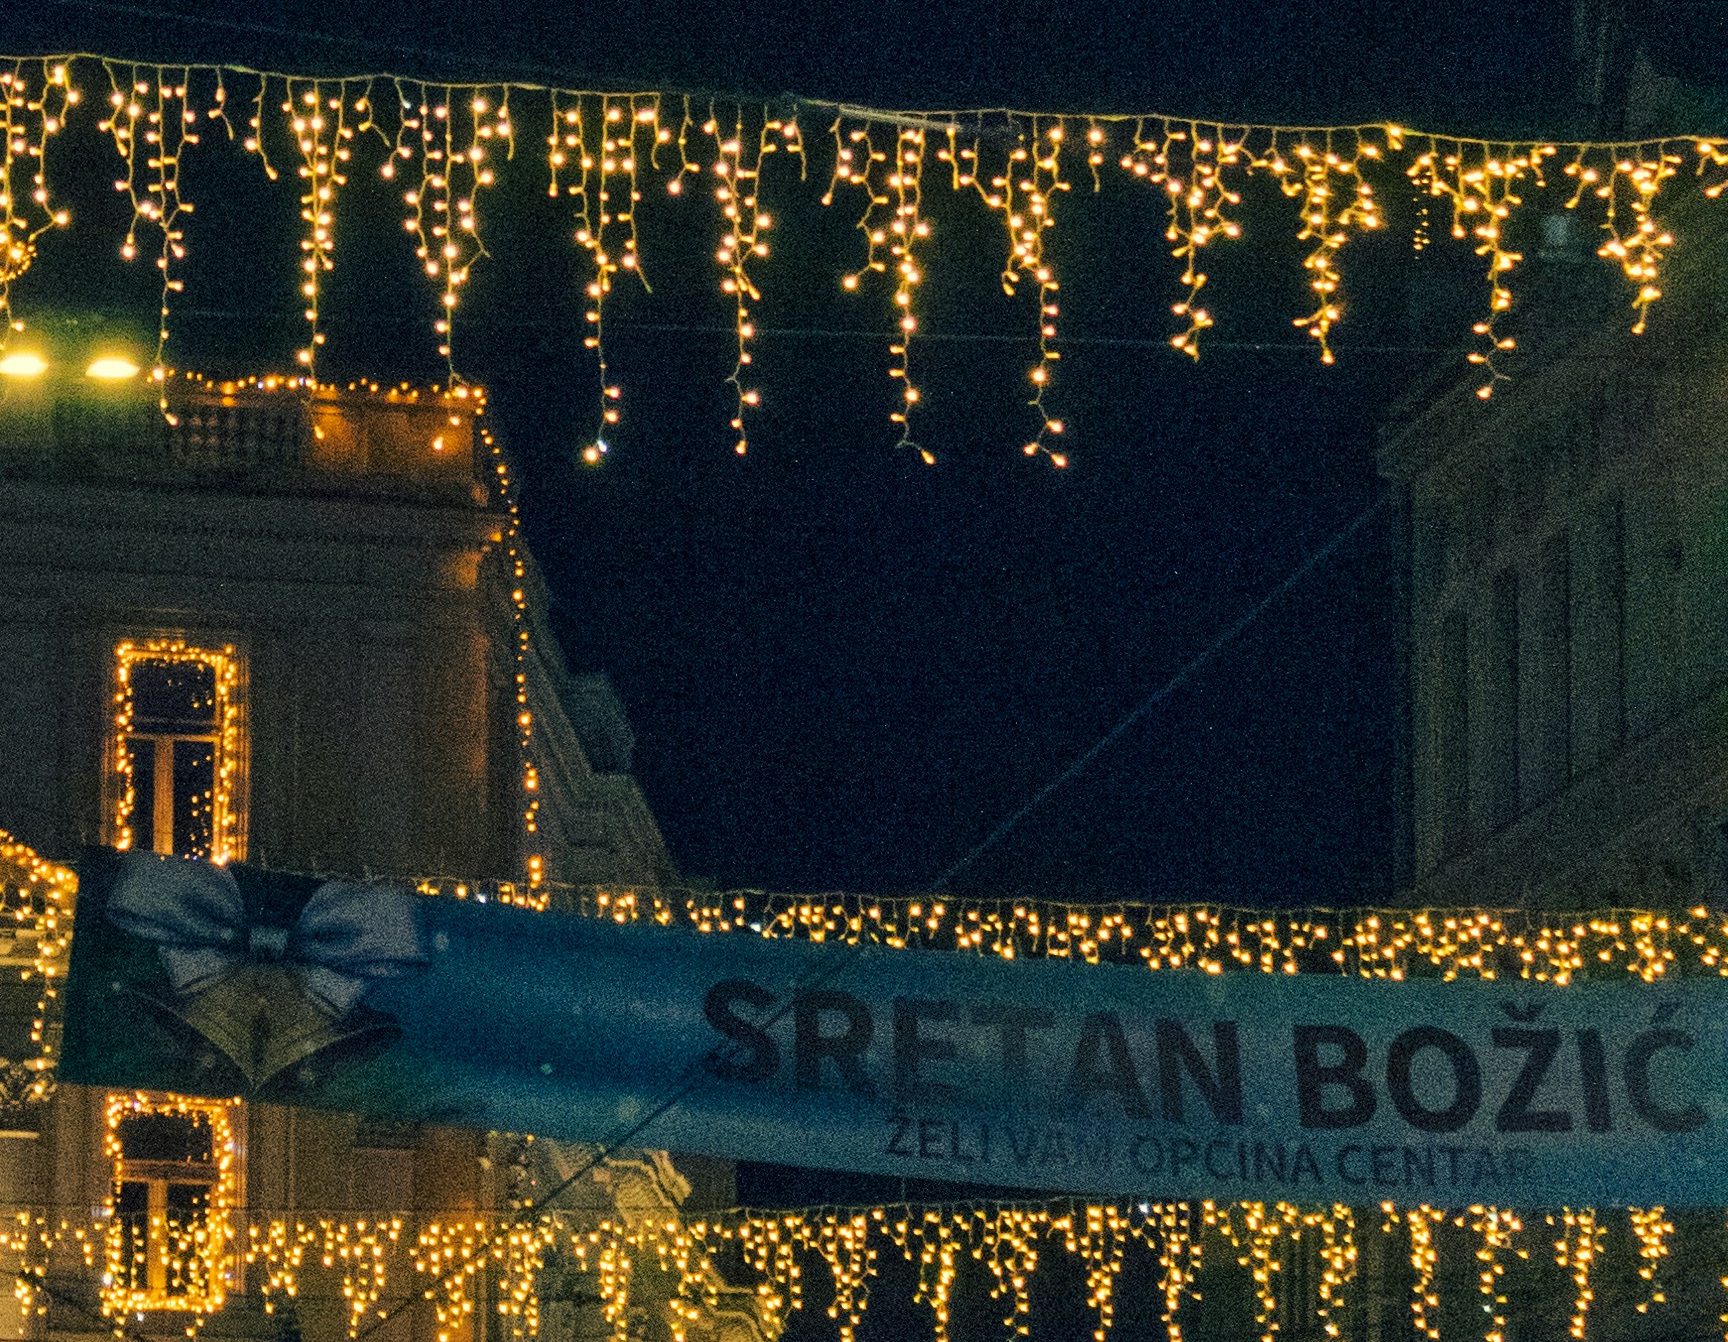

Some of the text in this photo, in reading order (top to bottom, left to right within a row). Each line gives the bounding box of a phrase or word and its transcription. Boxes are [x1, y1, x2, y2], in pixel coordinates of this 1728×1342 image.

[702, 979, 1710, 1134] SRETAN BOŽIĆ
[885, 1106, 990, 1162] ŽELI
[1005, 1124, 1111, 1170] VAM
[1336, 1143, 1536, 1187] CENTAR
